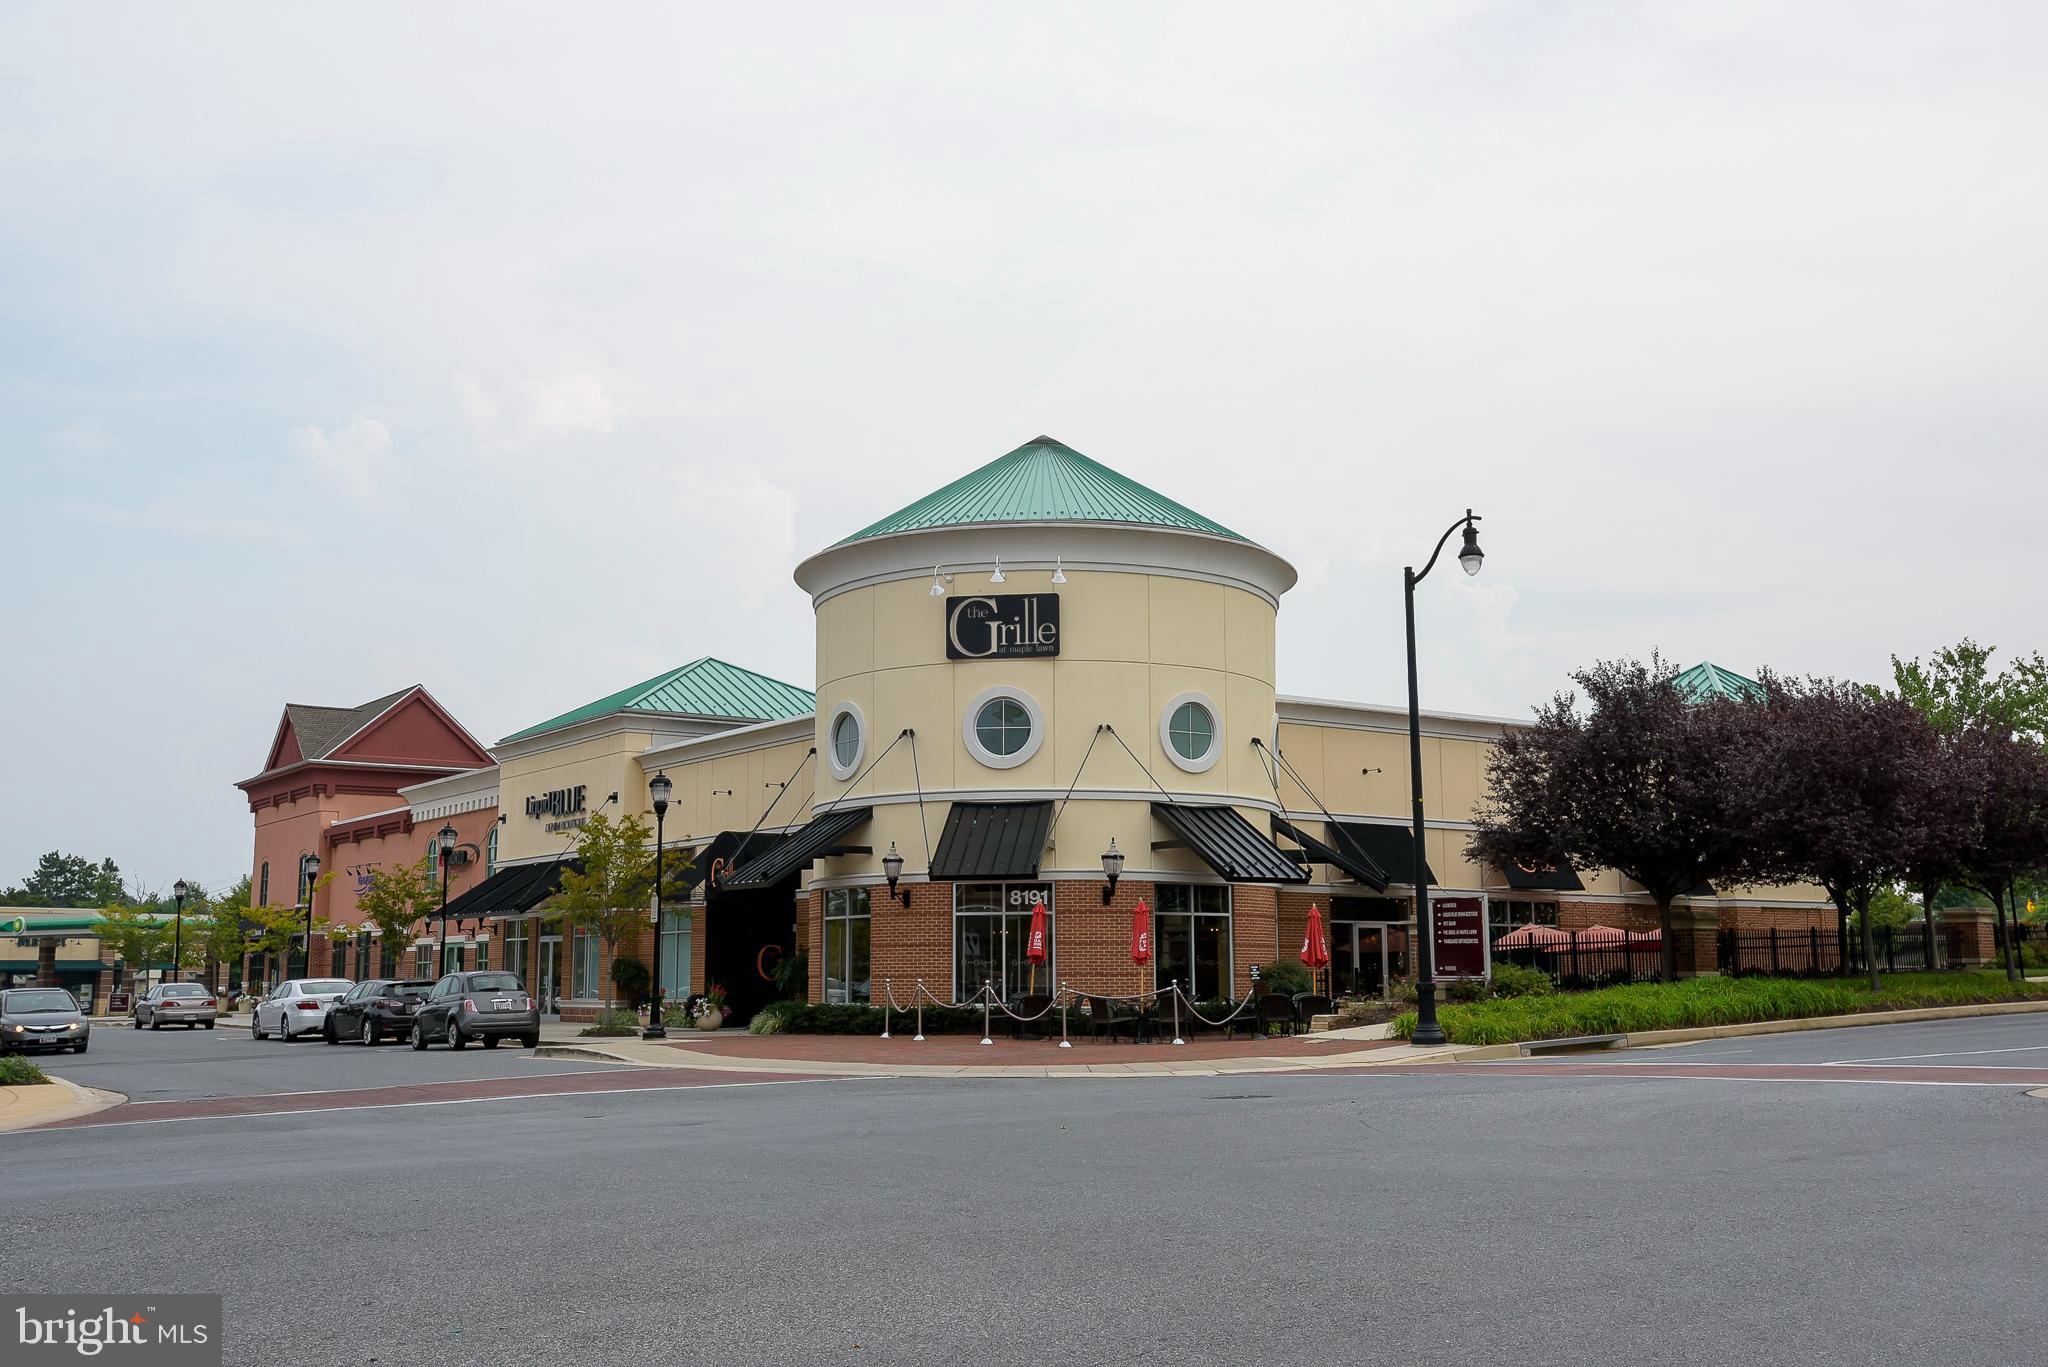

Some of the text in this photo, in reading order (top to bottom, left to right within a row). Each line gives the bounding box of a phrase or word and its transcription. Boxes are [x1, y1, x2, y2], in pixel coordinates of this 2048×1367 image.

[967, 606, 989, 619] the
[949, 597, 1057, 657] Grille
[998, 643, 1054, 655] at maple lawn
[1010, 889, 1048, 905] 8191
